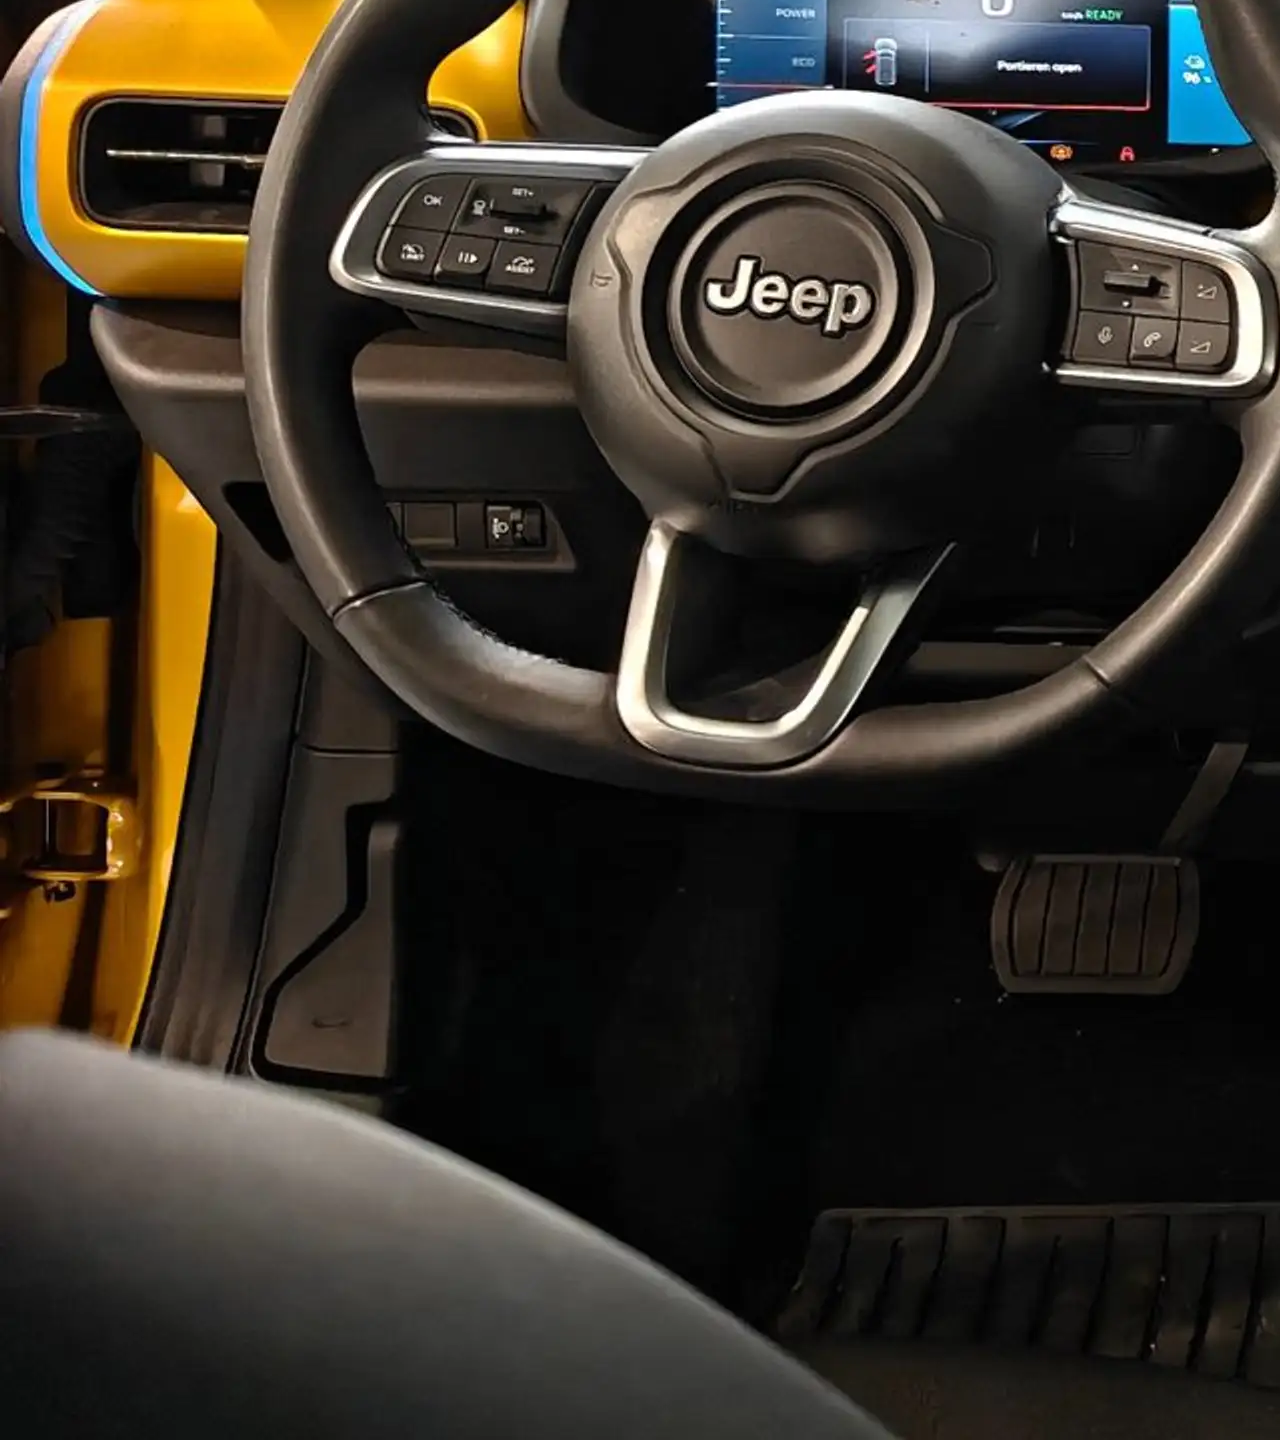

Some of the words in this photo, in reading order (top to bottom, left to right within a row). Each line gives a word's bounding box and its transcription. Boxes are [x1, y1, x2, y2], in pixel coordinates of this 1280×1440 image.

[775, 7, 816, 19] POWER
[1085, 9, 1123, 21] READY
[792, 57, 816, 68] ECO
[997, 60, 1051, 72] Portieren
[1052, 63, 1083, 74] open
[1183, 72, 1200, 85] 96
[423, 194, 444, 207] OK
[706, 257, 875, 336] Jeep
